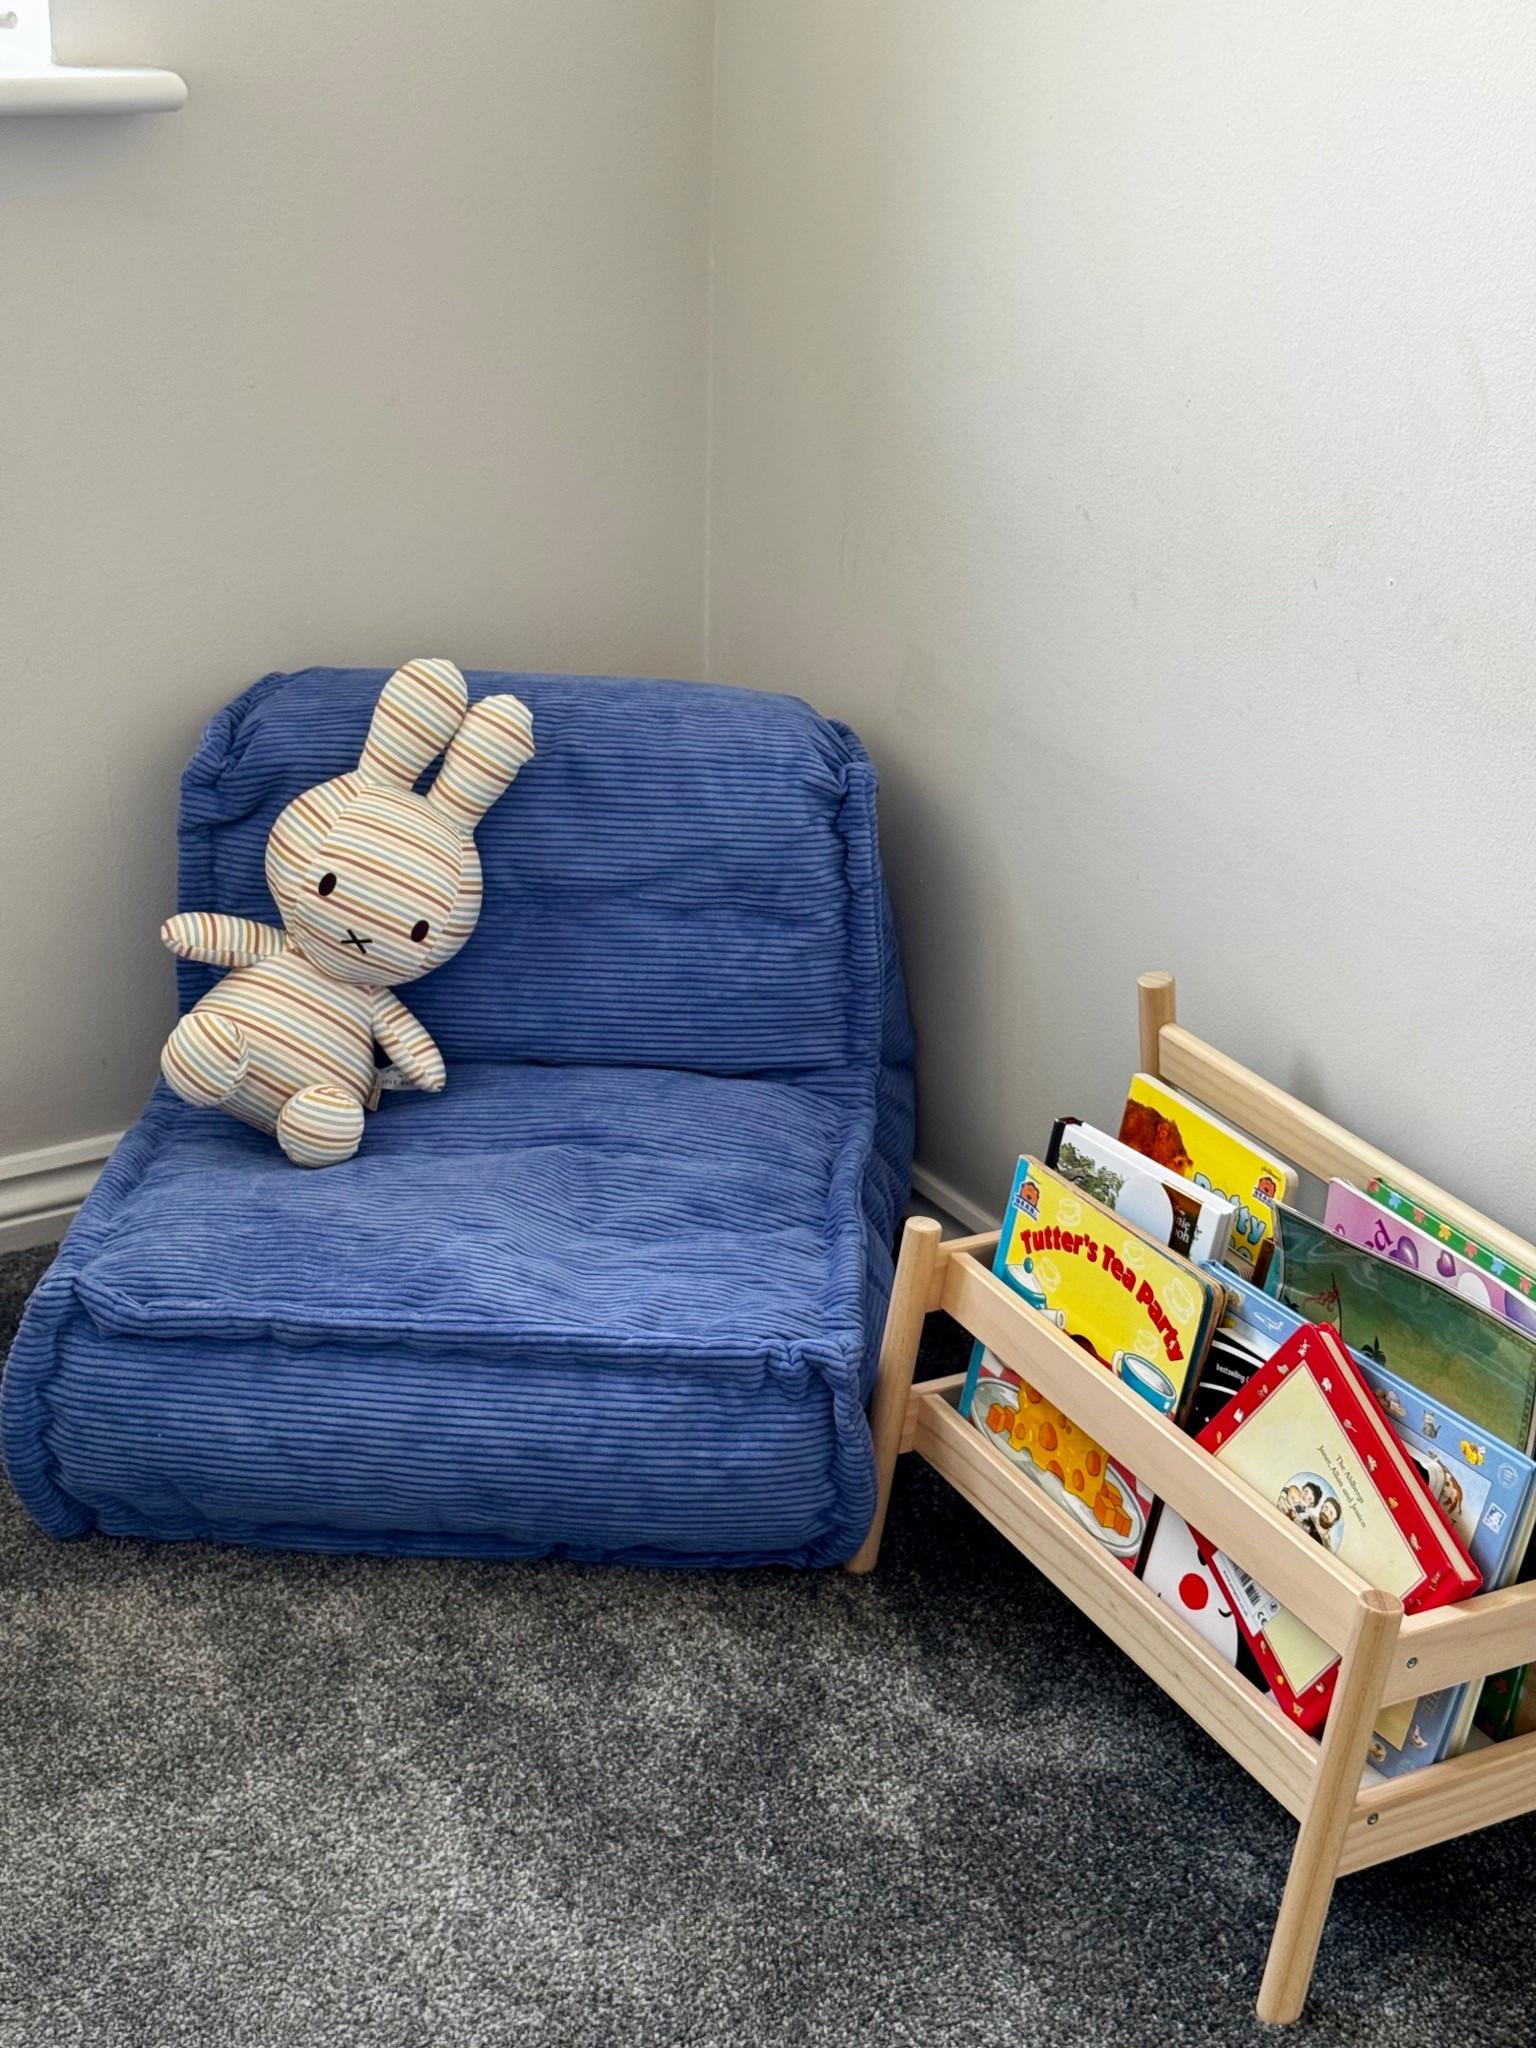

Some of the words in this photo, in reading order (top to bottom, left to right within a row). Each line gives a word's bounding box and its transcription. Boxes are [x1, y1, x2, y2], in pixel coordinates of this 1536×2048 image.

[1020, 1225, 1098, 1262] Tutter's
[1102, 1244, 1136, 1293] Tea
[1136, 1279, 1184, 1361] Party
[1336, 1453, 1346, 1471] The
[1330, 1466, 1344, 1488] Allan
[1342, 1488, 1355, 1503] and
[1349, 1503, 1367, 1528] Jessica
